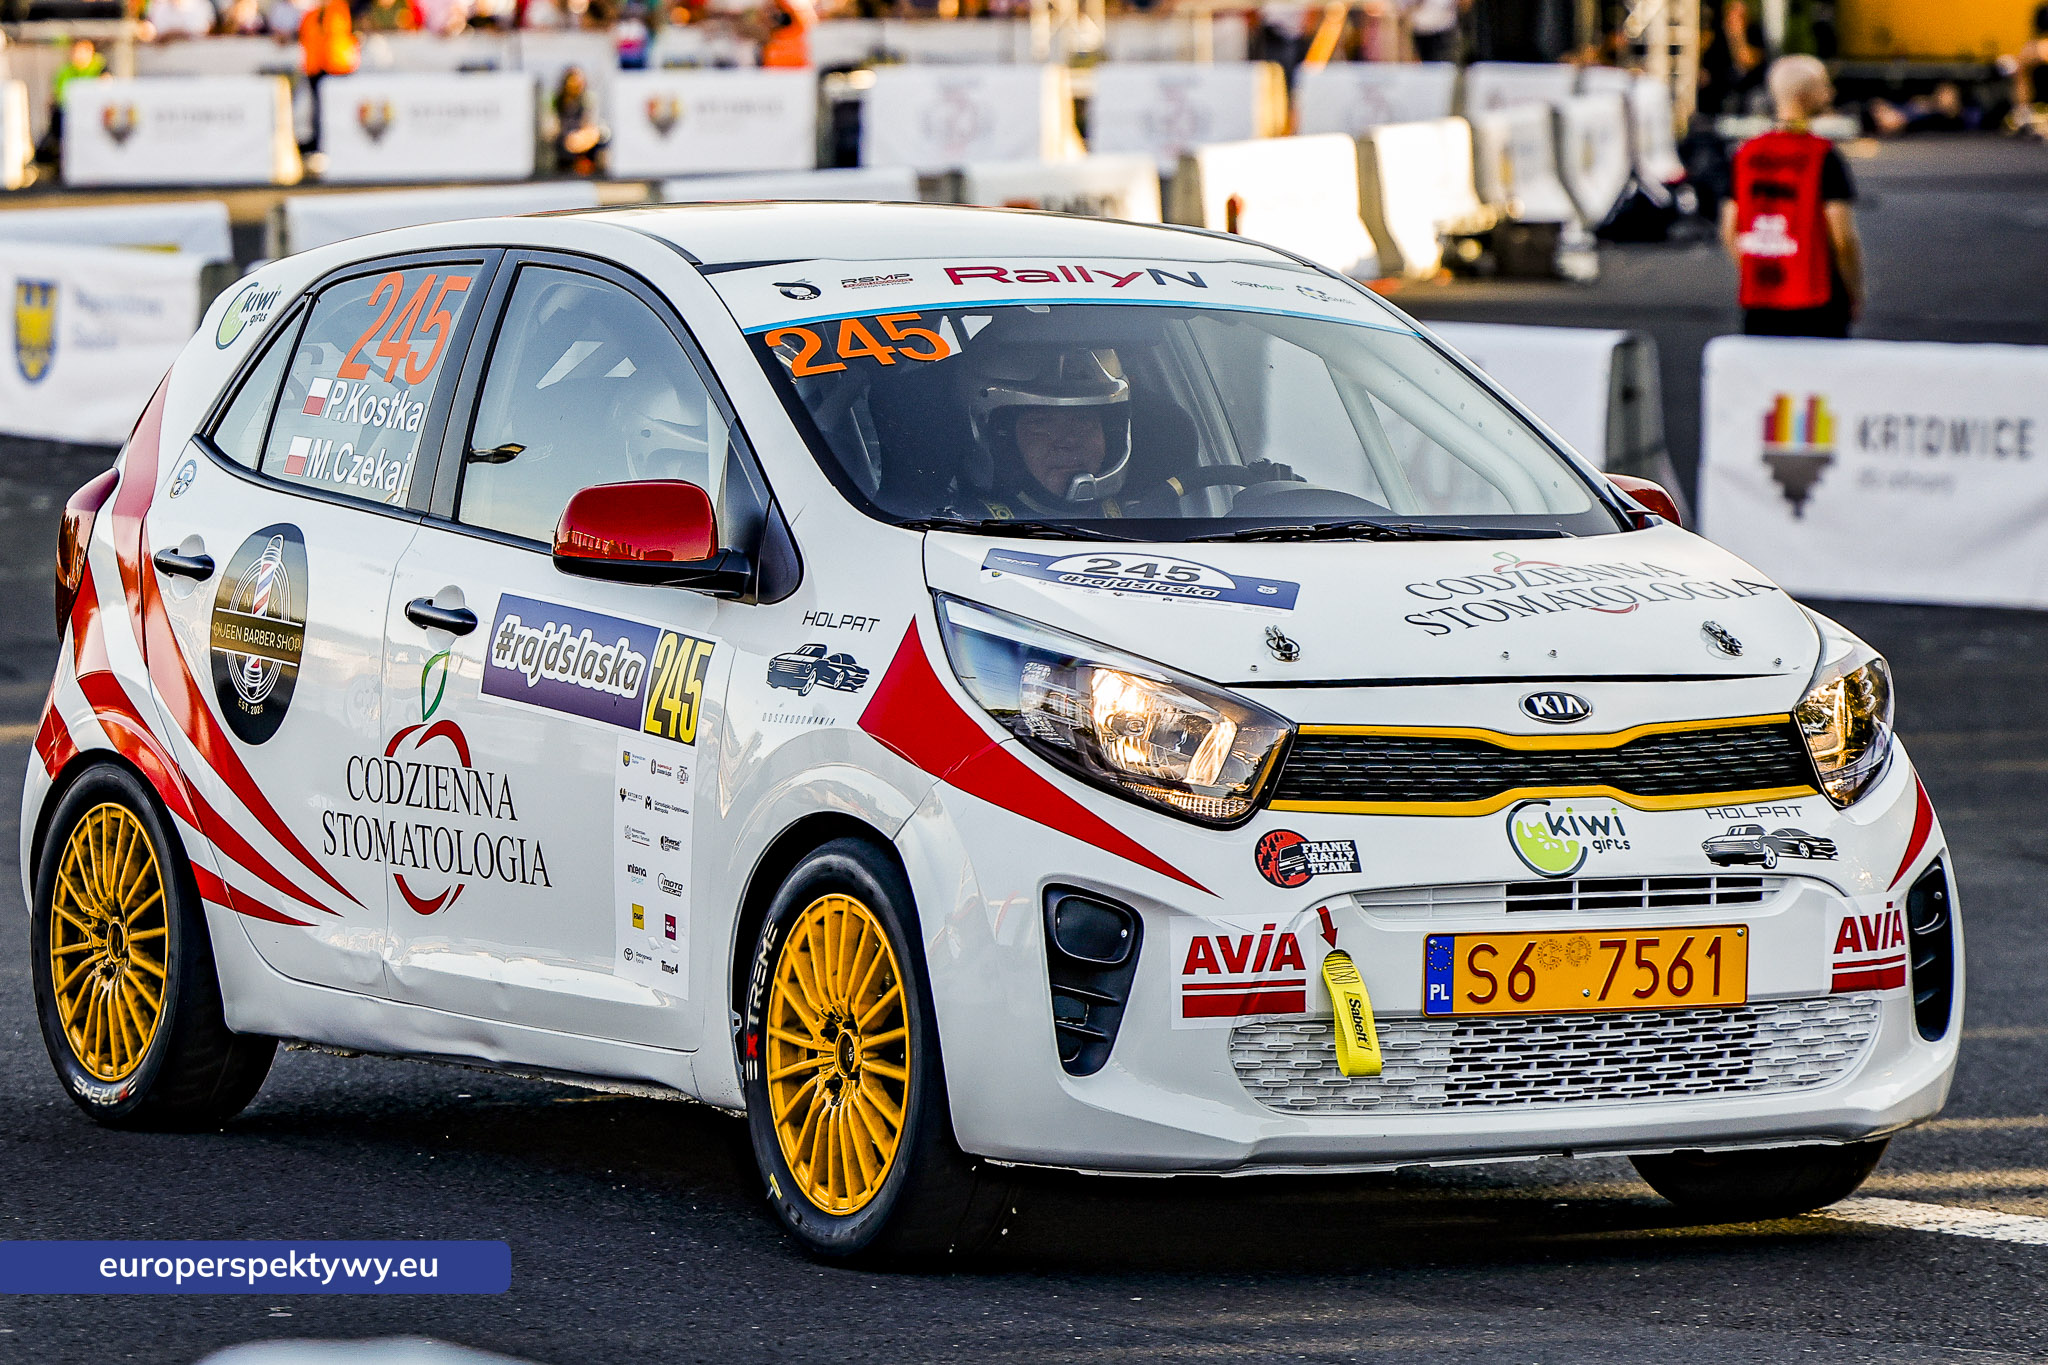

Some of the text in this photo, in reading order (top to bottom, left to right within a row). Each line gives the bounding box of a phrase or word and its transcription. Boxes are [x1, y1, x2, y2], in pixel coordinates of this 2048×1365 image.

[840, 273, 911, 285] RSMP
[943, 265, 1208, 288] RallyN
[241, 284, 282, 313] kiwi
[336, 271, 473, 385] 245
[764, 312, 951, 377] 245
[323, 379, 425, 432] P.Kostka
[305, 437, 413, 503] M.Czekaj
[1083, 557, 1202, 583] 245
[1404, 560, 1688, 601] CODZIENNA
[1062, 573, 1217, 597] #rajdslaska
[1404, 577, 1780, 637] STOMATOLOGIA
[213, 621, 243, 641] QUEEN
[242, 626, 276, 647] BARBER
[802, 610, 880, 632] HOLPAT
[495, 621, 642, 691] #rajdslaska
[644, 631, 715, 744] 245
[1530, 694, 1585, 715] KIA
[346, 754, 519, 822] CODZIENNA
[1545, 806, 1627, 837] kiwi
[1705, 804, 1803, 820] HOLPAT
[321, 809, 554, 888] STOMATOLOGIA
[1301, 840, 1353, 853] FRANK
[1308, 850, 1356, 863] RALLY
[1592, 838, 1632, 854] gifts
[1307, 861, 1352, 873] TEAM
[1466, 936, 1723, 1004] S6 7561
[1429, 983, 1450, 1001] PL
